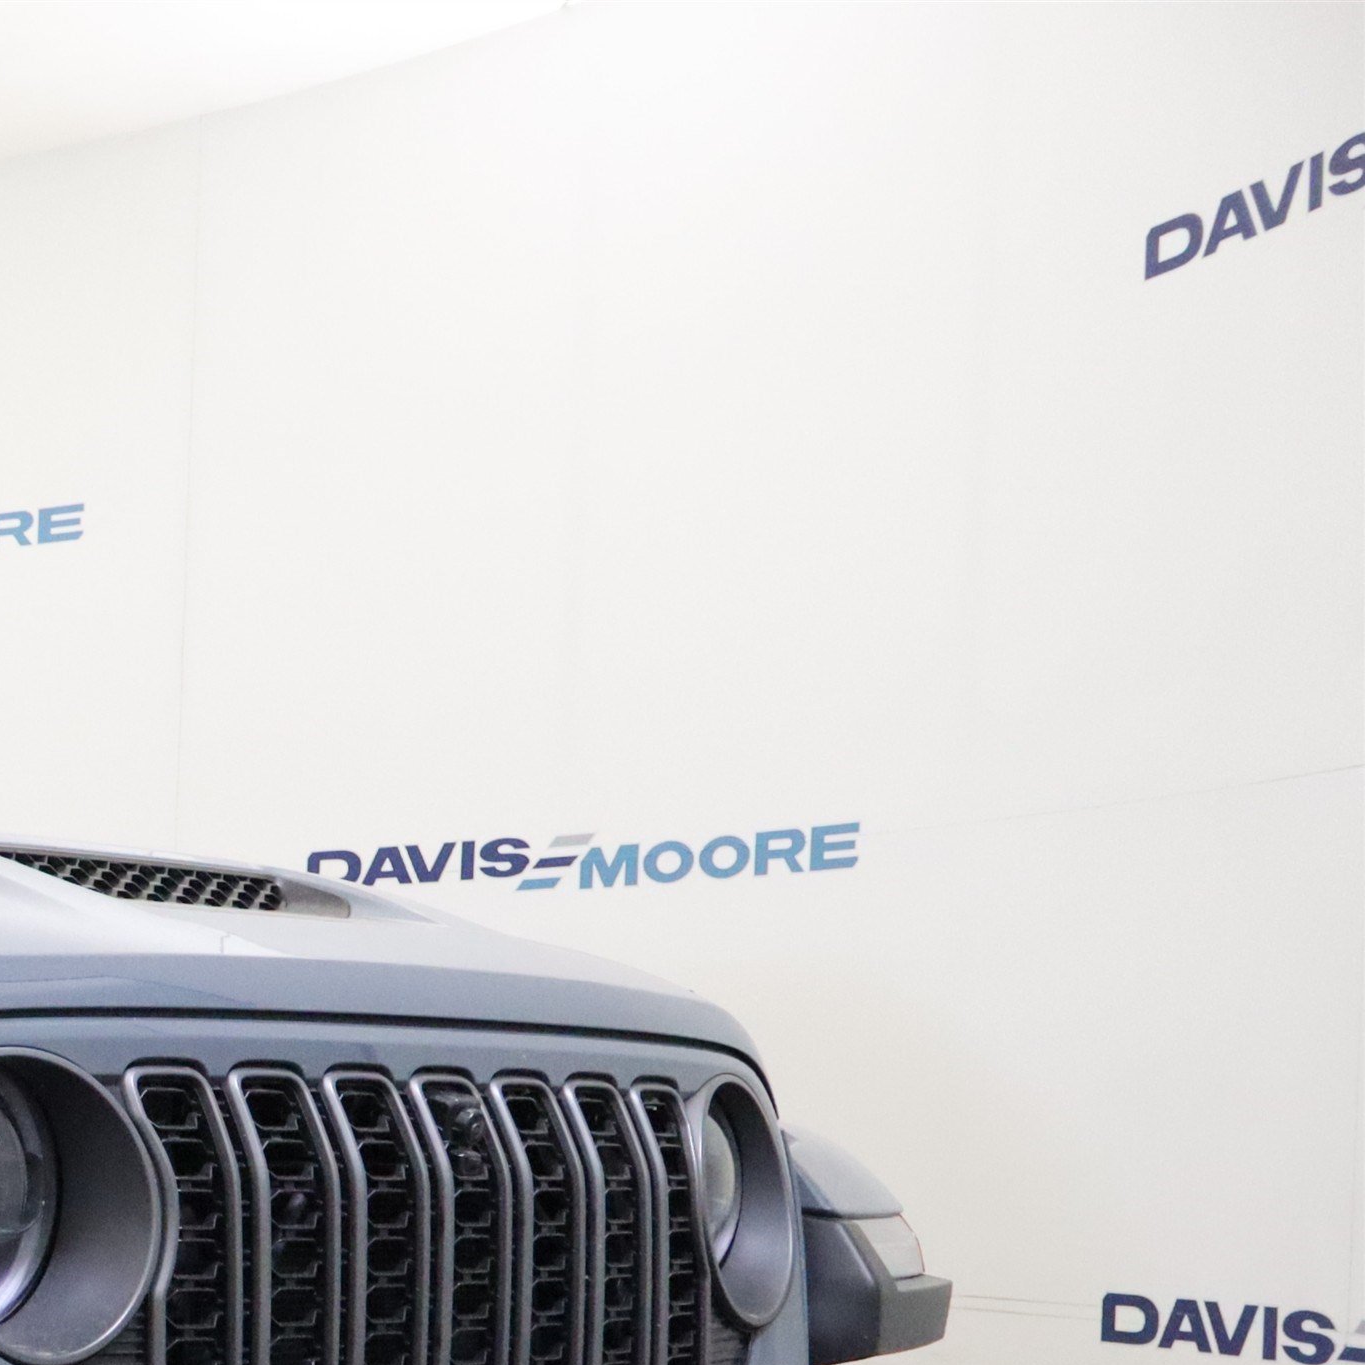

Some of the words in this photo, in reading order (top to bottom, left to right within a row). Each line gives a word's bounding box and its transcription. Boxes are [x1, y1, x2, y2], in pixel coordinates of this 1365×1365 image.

[1145, 131, 1365, 281] DAVIS
[307, 837, 531, 886] DAVIS
[579, 822, 860, 889] MOORE
[1100, 1293, 1336, 1365] DAVIS
